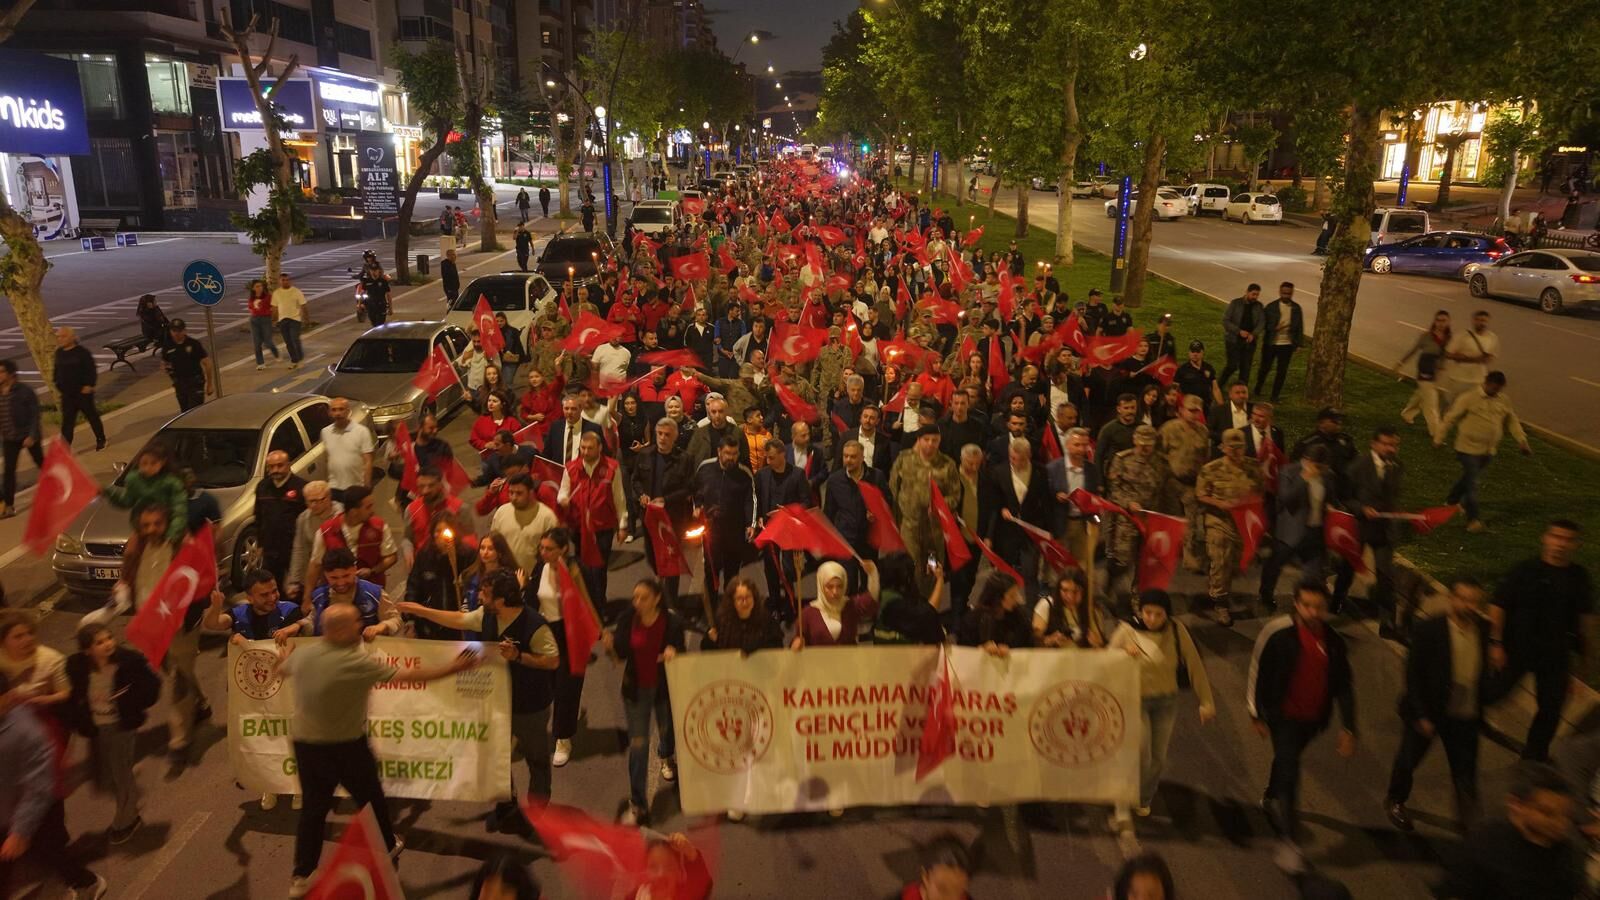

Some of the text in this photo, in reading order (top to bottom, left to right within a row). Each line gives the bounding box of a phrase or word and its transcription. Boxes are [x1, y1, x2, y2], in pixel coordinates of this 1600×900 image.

[368, 173, 388, 181] ALP
[96, 569, 105, 578] 46
[404, 656, 421, 669] VE
[243, 719, 489, 744] BATI KEŞ SOLMAZ
[795, 709, 897, 738] GENÇLİK
[954, 716, 1005, 738] POR
[806, 737, 826, 762] İL
